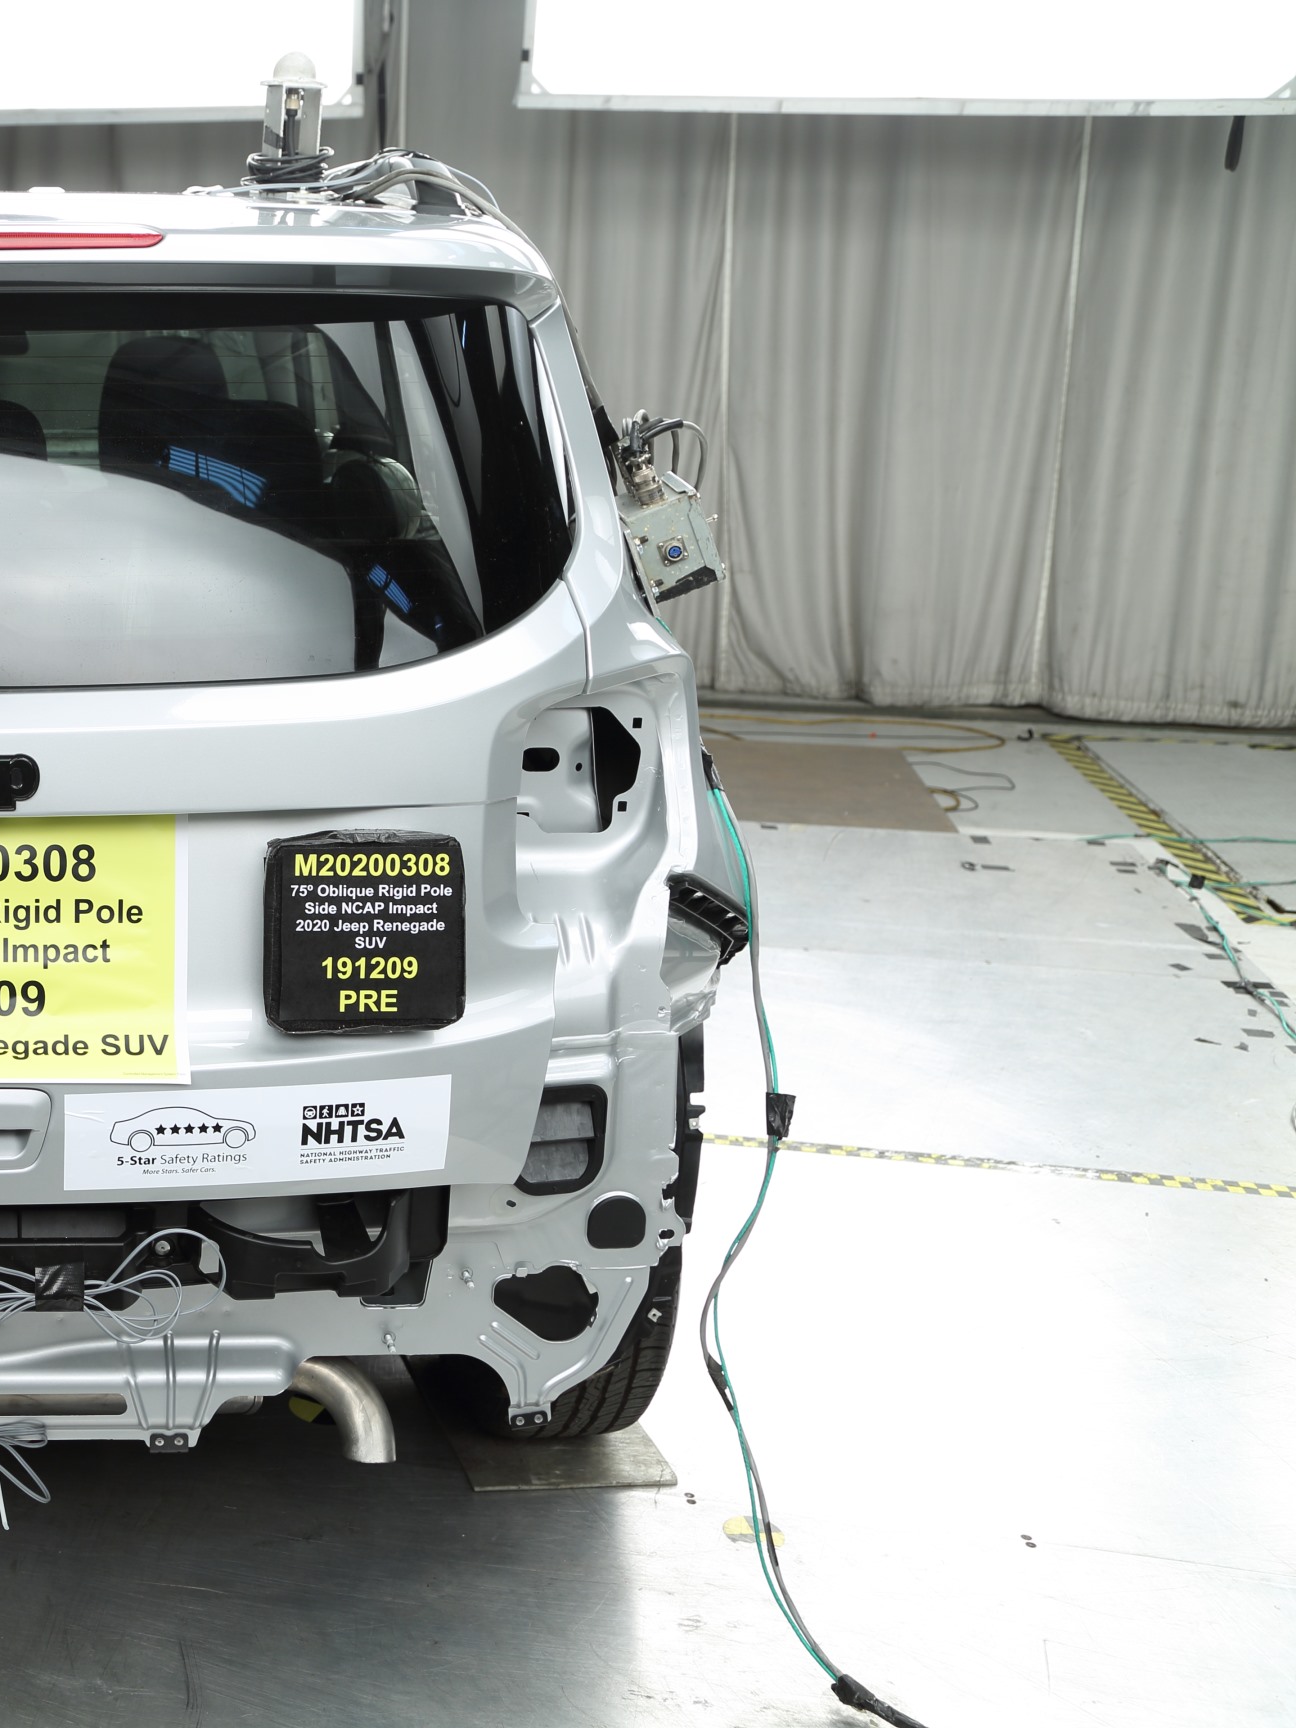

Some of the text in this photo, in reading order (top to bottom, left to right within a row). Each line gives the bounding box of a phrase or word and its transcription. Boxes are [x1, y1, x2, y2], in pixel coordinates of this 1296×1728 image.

[294, 853, 450, 877] M20200308
[317, 884, 375, 899] Oblique
[378, 884, 417, 899] Rigid
[421, 883, 453, 897] Pole
[74, 898, 144, 924] Pole
[304, 902, 438, 917] Side NCAP Impact
[295, 919, 446, 935] 2020 Jeep Renegade
[354, 936, 387, 949] SUV
[2, 937, 111, 970] Impact
[321, 956, 418, 980] 191209
[339, 989, 398, 1013] PRE
[100, 1033, 169, 1056] SUV
[300, 1116, 406, 1146] NHTSA
[116, 1152, 247, 1166] 5-Star Safety Ratings
[328, 1154, 391, 1163] ADMINISTRATION
[338, 1148, 373, 1156] HIGHWAY
[375, 1146, 405, 1154] TRAFFIC
